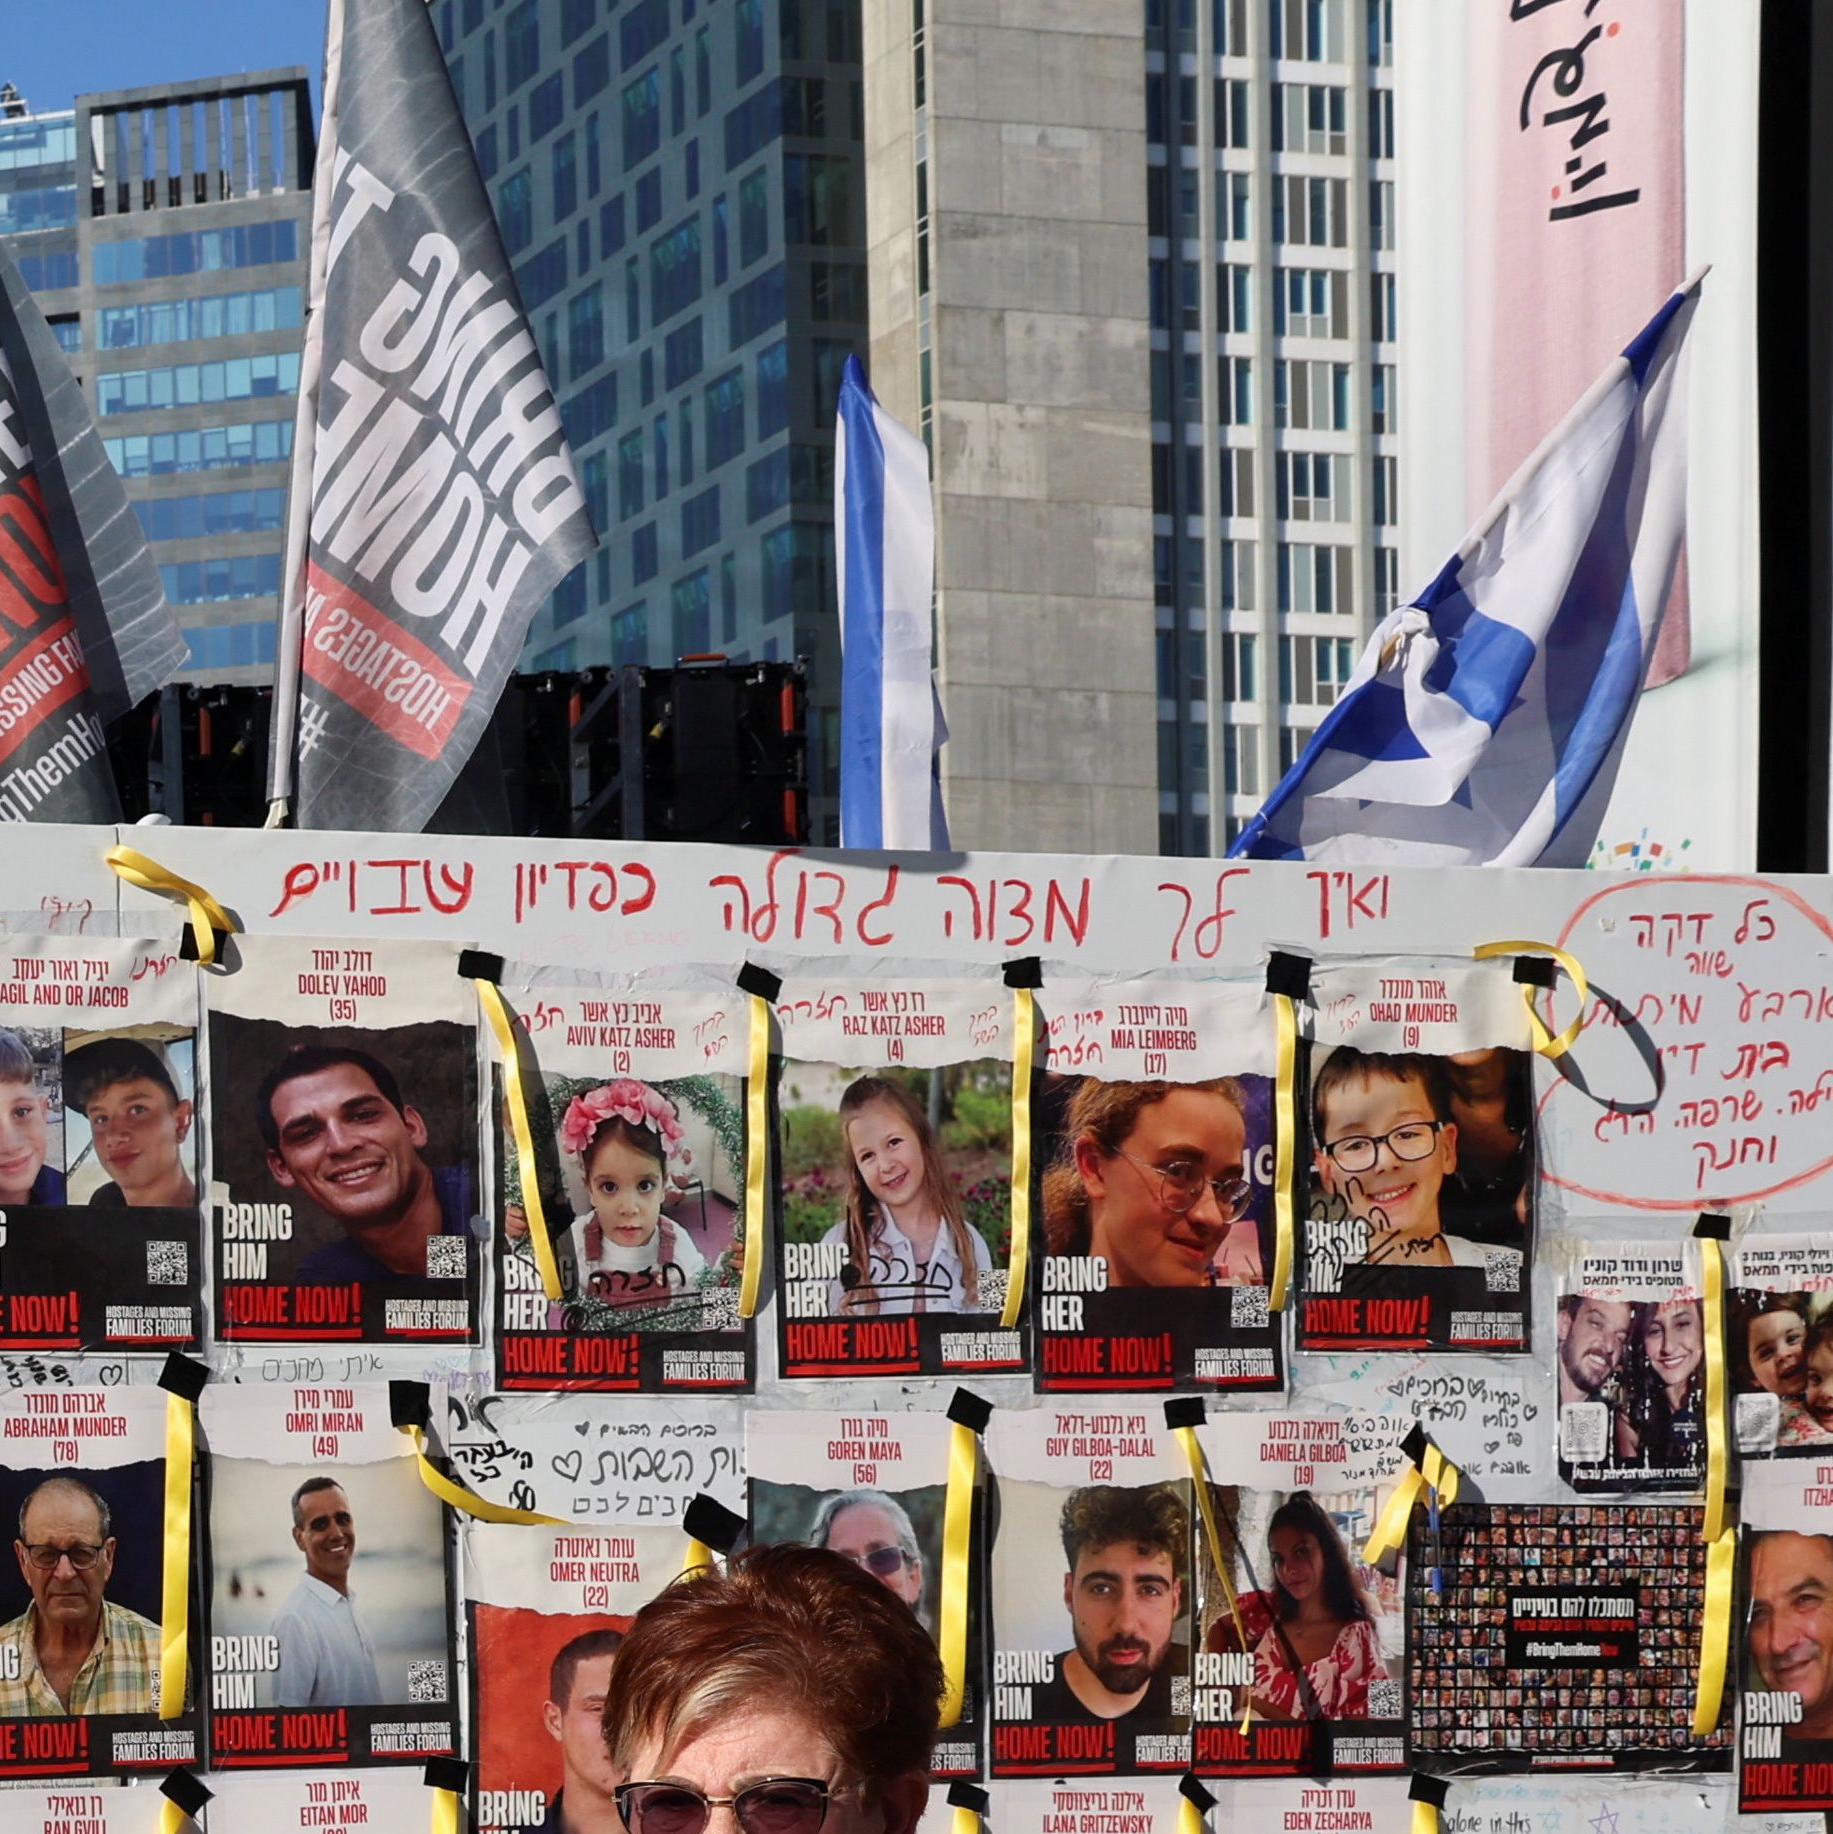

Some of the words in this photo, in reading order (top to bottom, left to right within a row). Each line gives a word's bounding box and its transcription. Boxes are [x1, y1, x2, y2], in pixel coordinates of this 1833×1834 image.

[710, 848, 900, 946] גדולה
[937, 876, 1091, 947] מצוה
[1158, 867, 1251, 962] לך
[1735, 900, 1777, 944] כל
[1629, 913, 1713, 956] דקה
[1684, 951, 1734, 977] שווה
[34, 985, 60, 1004] AND
[66, 986, 83, 1005] OR
[89, 987, 128, 1007] JACOB
[299, 975, 338, 994] DOLEV
[345, 976, 385, 996] YAHOD
[843, 1016, 867, 1035] RAZ
[871, 1016, 900, 1035] KATZ
[905, 1016, 944, 1035] ASHER
[1583, 1258, 1617, 1275] קוניו
[1621, 1259, 1648, 1273] ודוד
[1652, 1259, 1683, 1272] שרון
[5, 1419, 68, 1437] ABRAHAM
[74, 1417, 125, 1436] MUNDER
[1047, 1438, 1069, 1456] GUY
[1073, 1439, 1154, 1456] GILBOA-DALAL
[551, 1563, 585, 1581] OMER
[590, 1563, 638, 1581] NEUTRA
[1448, 1814, 1482, 1834] alone
[1491, 1815, 1503, 1834] in
[1505, 1811, 1531, 1833] this
